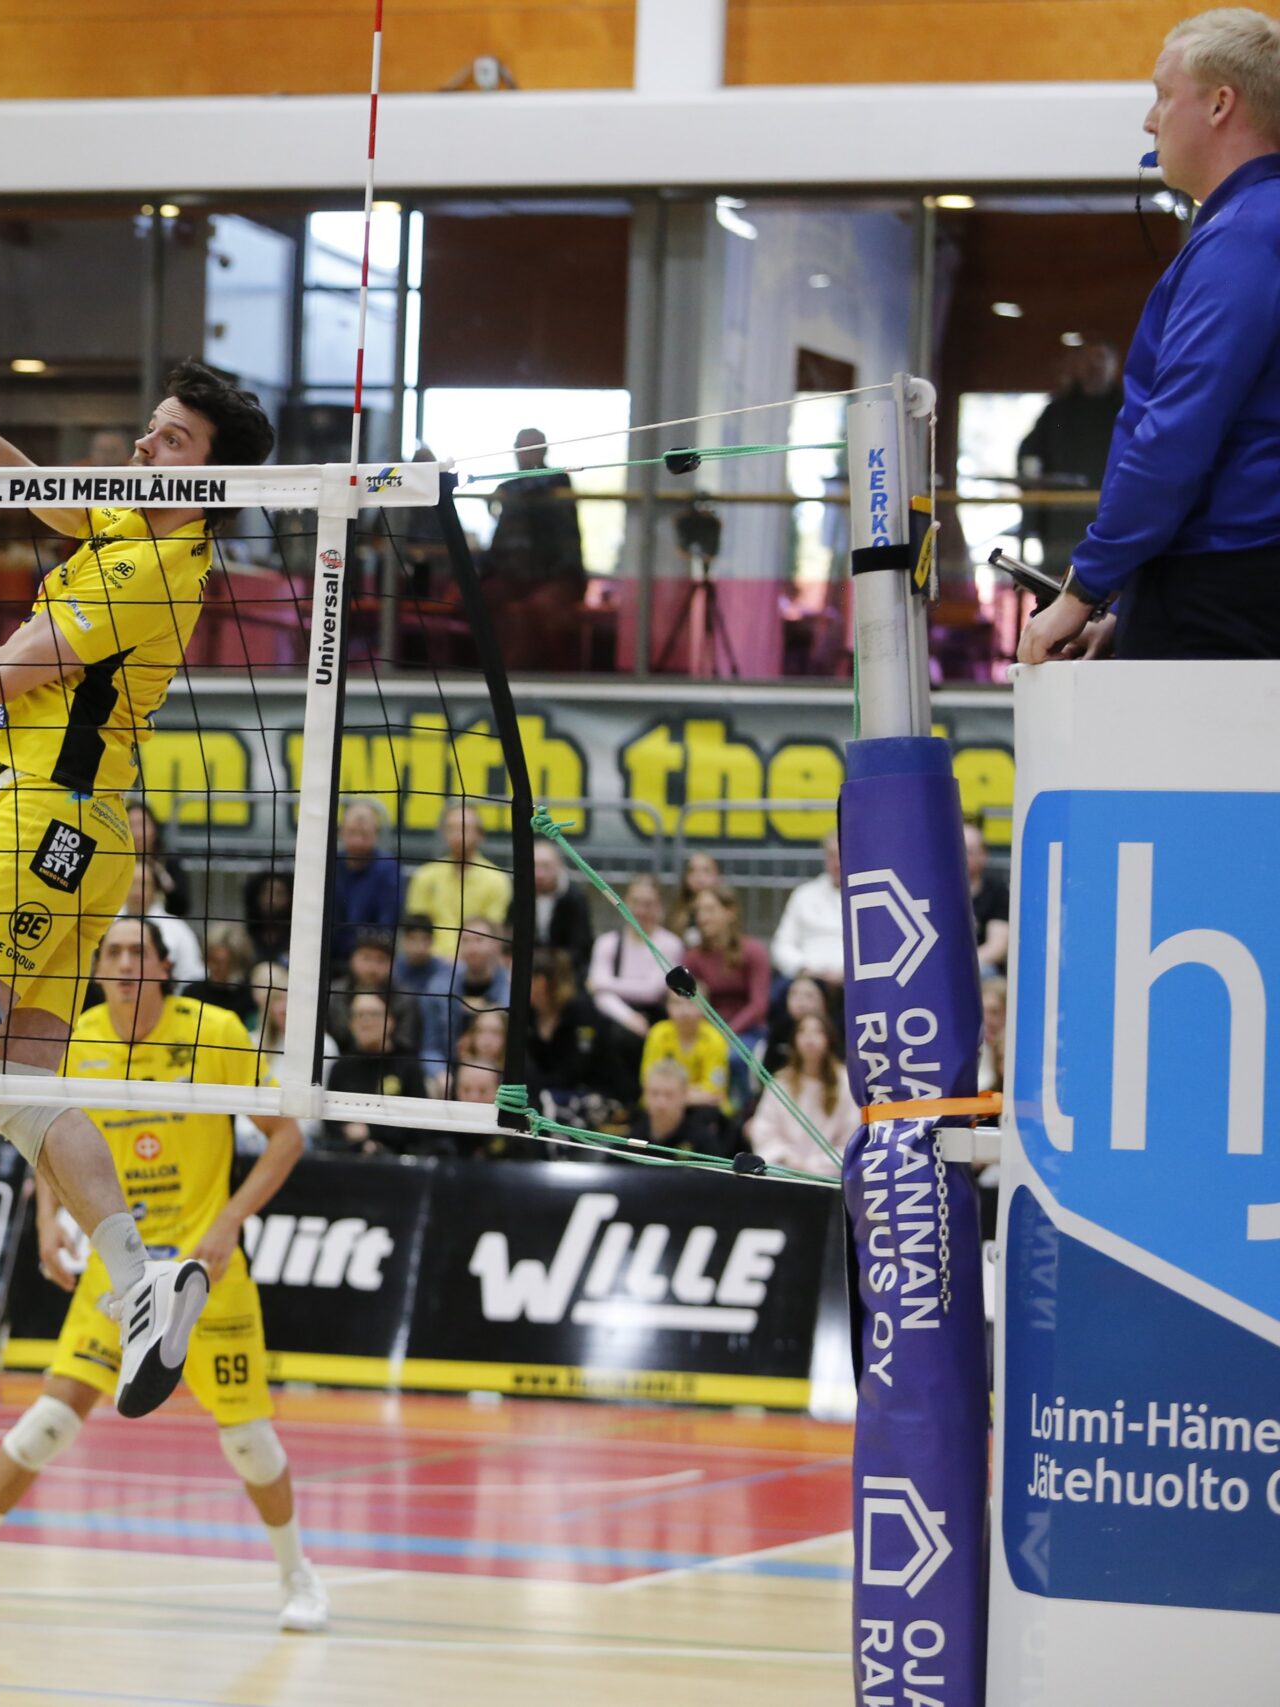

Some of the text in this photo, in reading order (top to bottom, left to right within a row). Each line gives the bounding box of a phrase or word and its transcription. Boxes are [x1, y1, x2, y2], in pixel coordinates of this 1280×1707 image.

[9, 479, 66, 502] PASI
[72, 474, 226, 503] MERILÄINEN
[367, 475, 402, 488] HUCK
[316, 572, 339, 686] Universal
[624, 718, 846, 841] the
[54, 825, 80, 849] HO
[42, 853, 77, 878] STY
[13, 911, 49, 940] BE
[5, 947, 36, 971] GROUP
[243, 1214, 395, 1292] lift
[468, 1192, 788, 1324] WILLE
[868, 1313, 894, 1387] OY
[215, 1353, 249, 1385] 69
[1027, 1453, 1250, 1512] Jätehuolto
